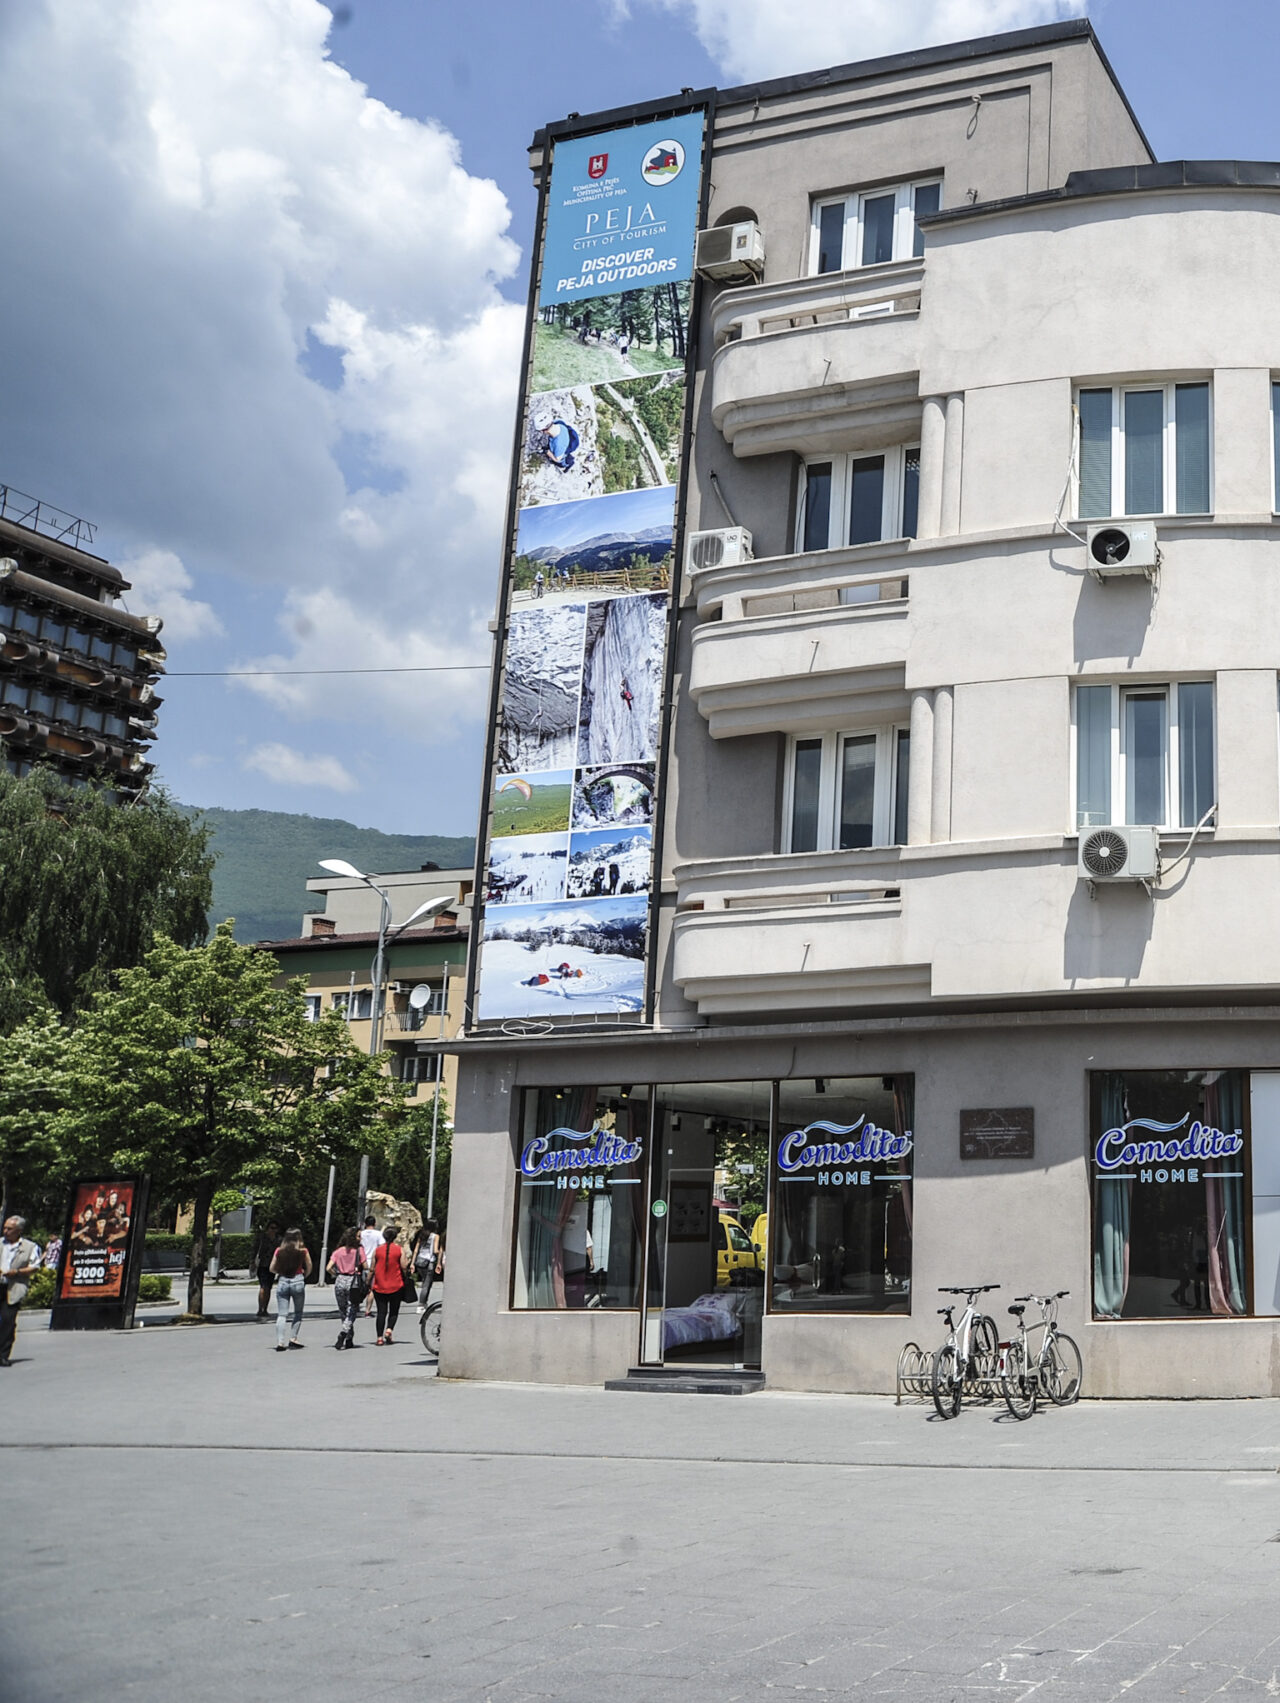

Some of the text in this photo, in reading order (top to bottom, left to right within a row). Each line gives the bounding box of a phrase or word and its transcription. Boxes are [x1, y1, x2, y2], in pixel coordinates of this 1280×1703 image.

[563, 193, 604, 206] MUNICIPALITY
[585, 202, 656, 234] PEJA
[573, 226, 667, 251] CITY OF TOURISM
[581, 247, 655, 273] DISCOVER
[556, 257, 678, 292] PEJA OUTDOORS
[521, 1129, 643, 1177] Comodita
[777, 1122, 913, 1173] Comodita
[1095, 1120, 1243, 1171] Comodita
[557, 1175, 605, 1189] HOME
[818, 1171, 871, 1186] HOME
[1140, 1168, 1199, 1183] HOME
[74, 1266, 105, 1279] 3000
